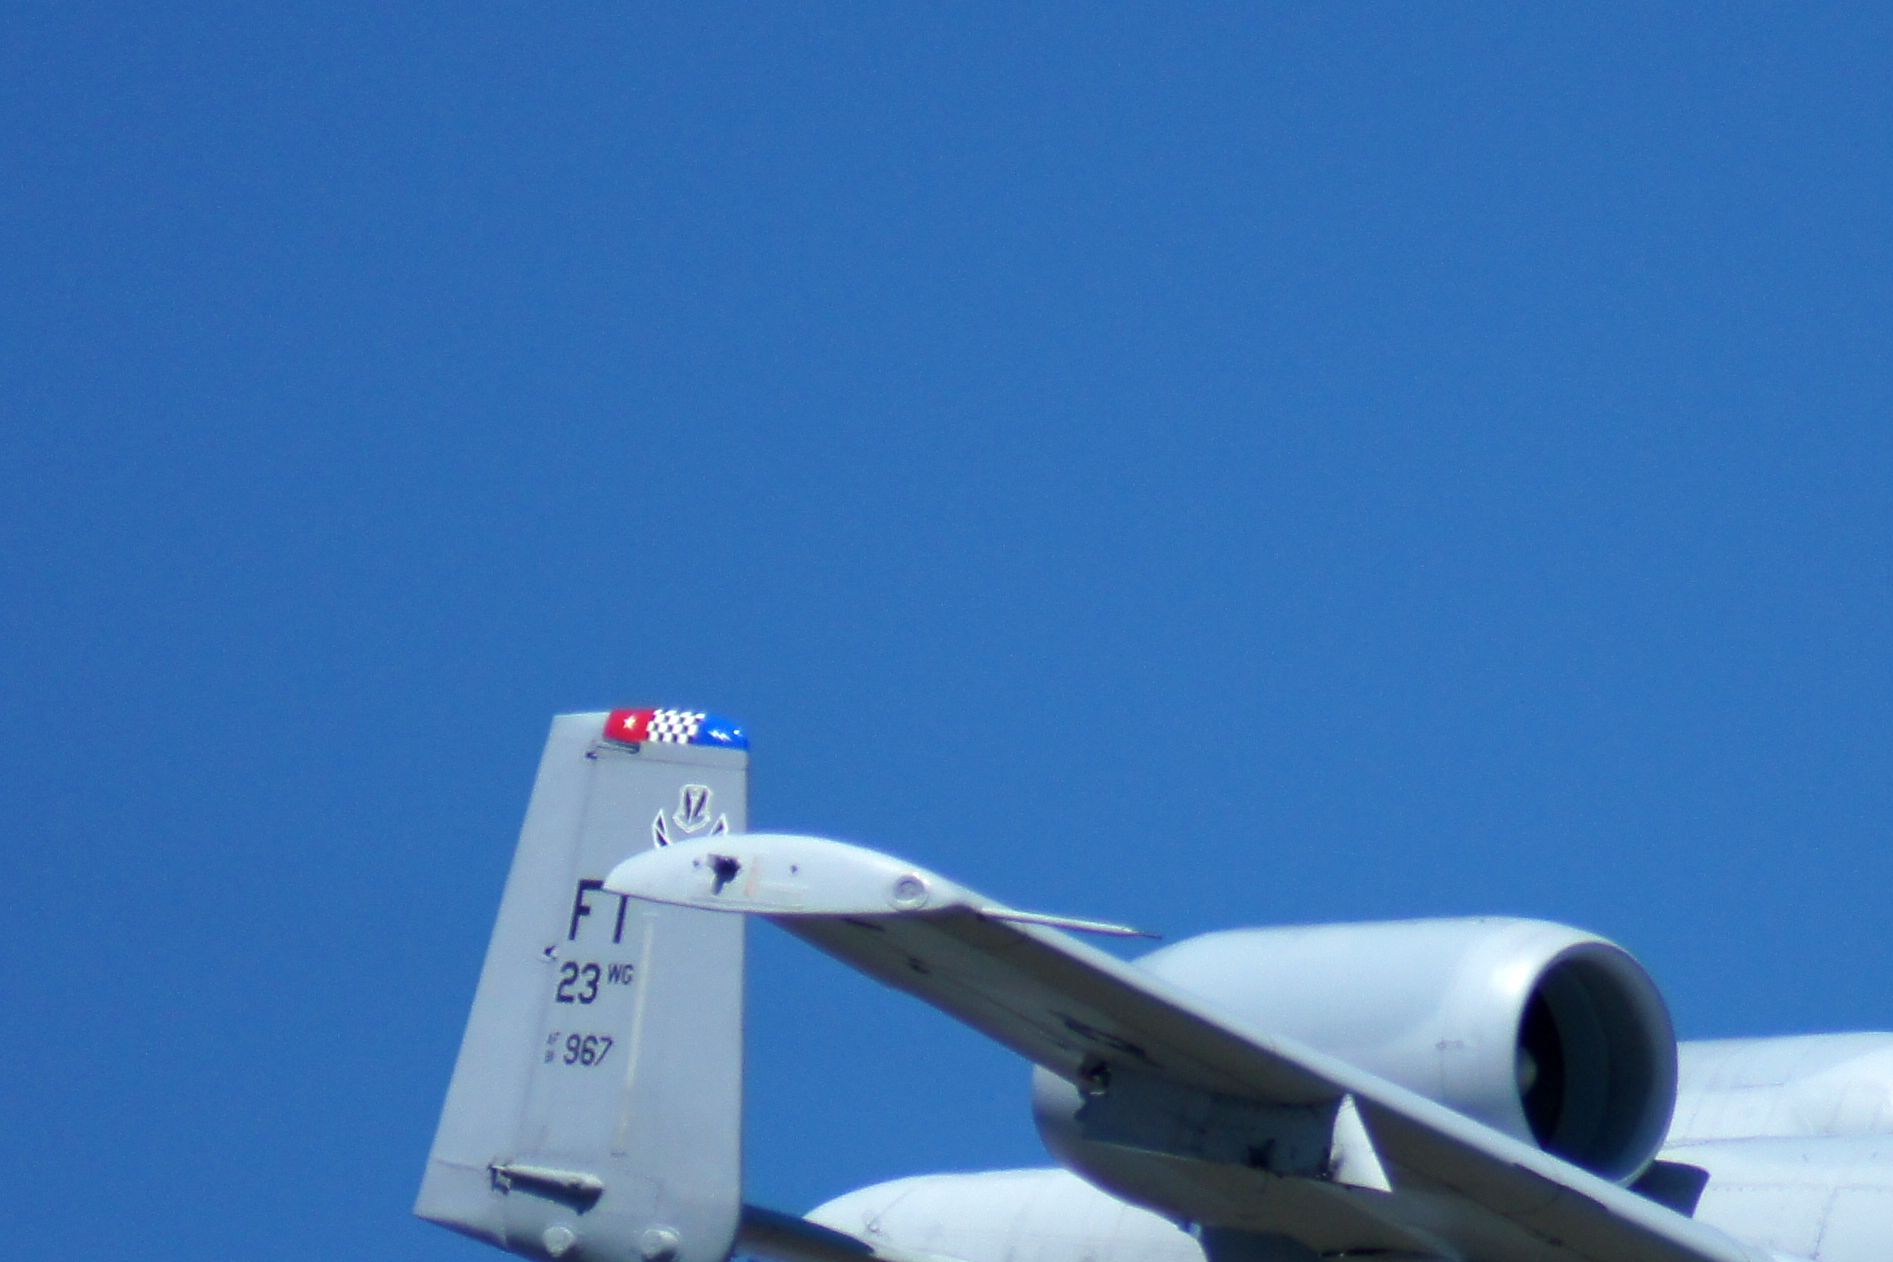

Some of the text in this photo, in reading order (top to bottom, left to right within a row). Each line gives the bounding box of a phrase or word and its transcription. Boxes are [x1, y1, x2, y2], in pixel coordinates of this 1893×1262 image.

[556, 961, 634, 1004] 23 WG
[563, 1033, 613, 1065] 967
